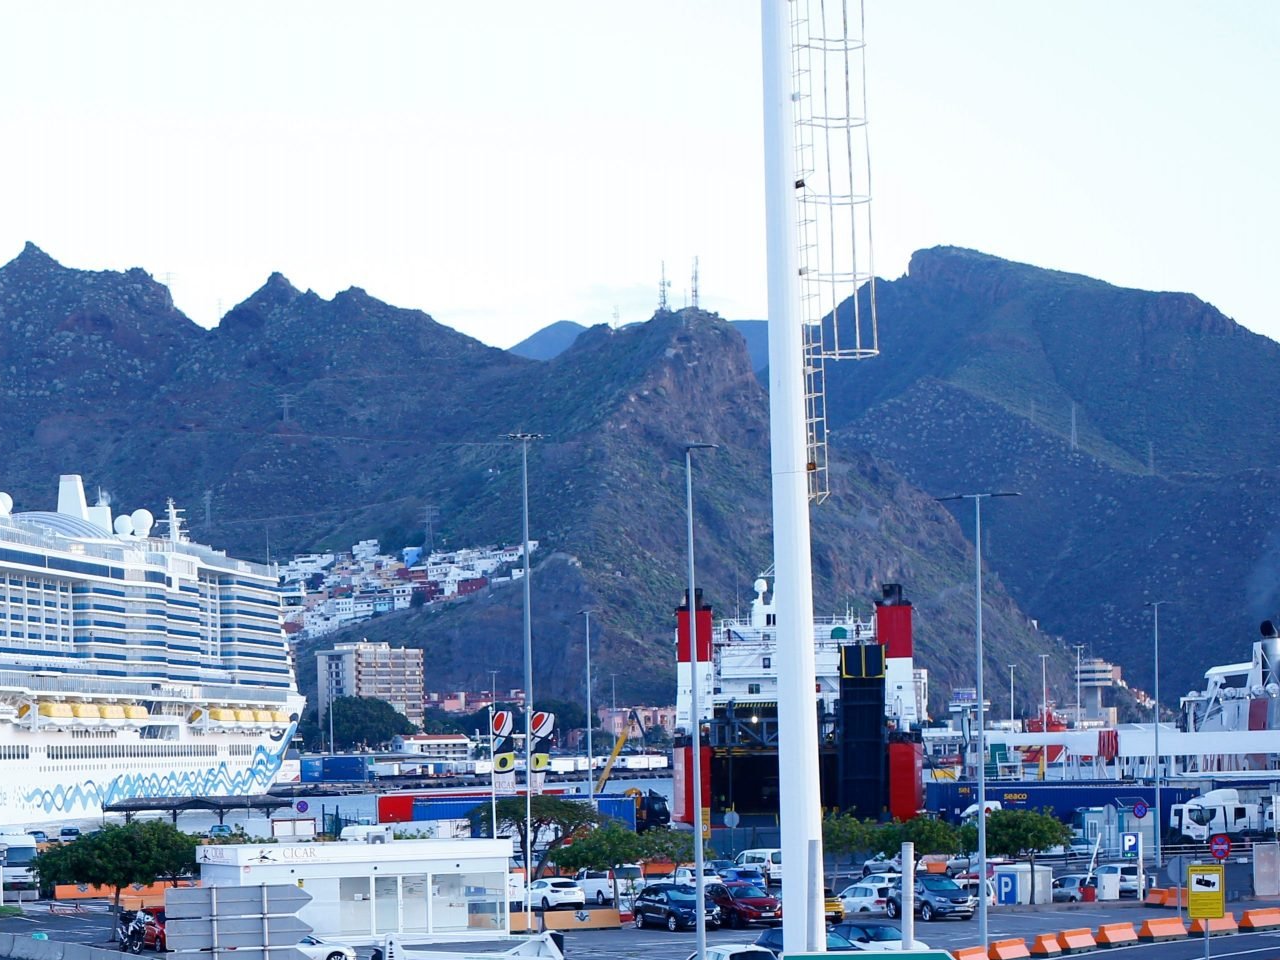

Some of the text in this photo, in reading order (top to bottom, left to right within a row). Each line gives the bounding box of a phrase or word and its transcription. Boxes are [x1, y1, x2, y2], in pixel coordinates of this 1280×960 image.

[1124, 835, 1136, 851] P
[282, 847, 316, 859] CICAR
[1001, 876, 1012, 901] P
